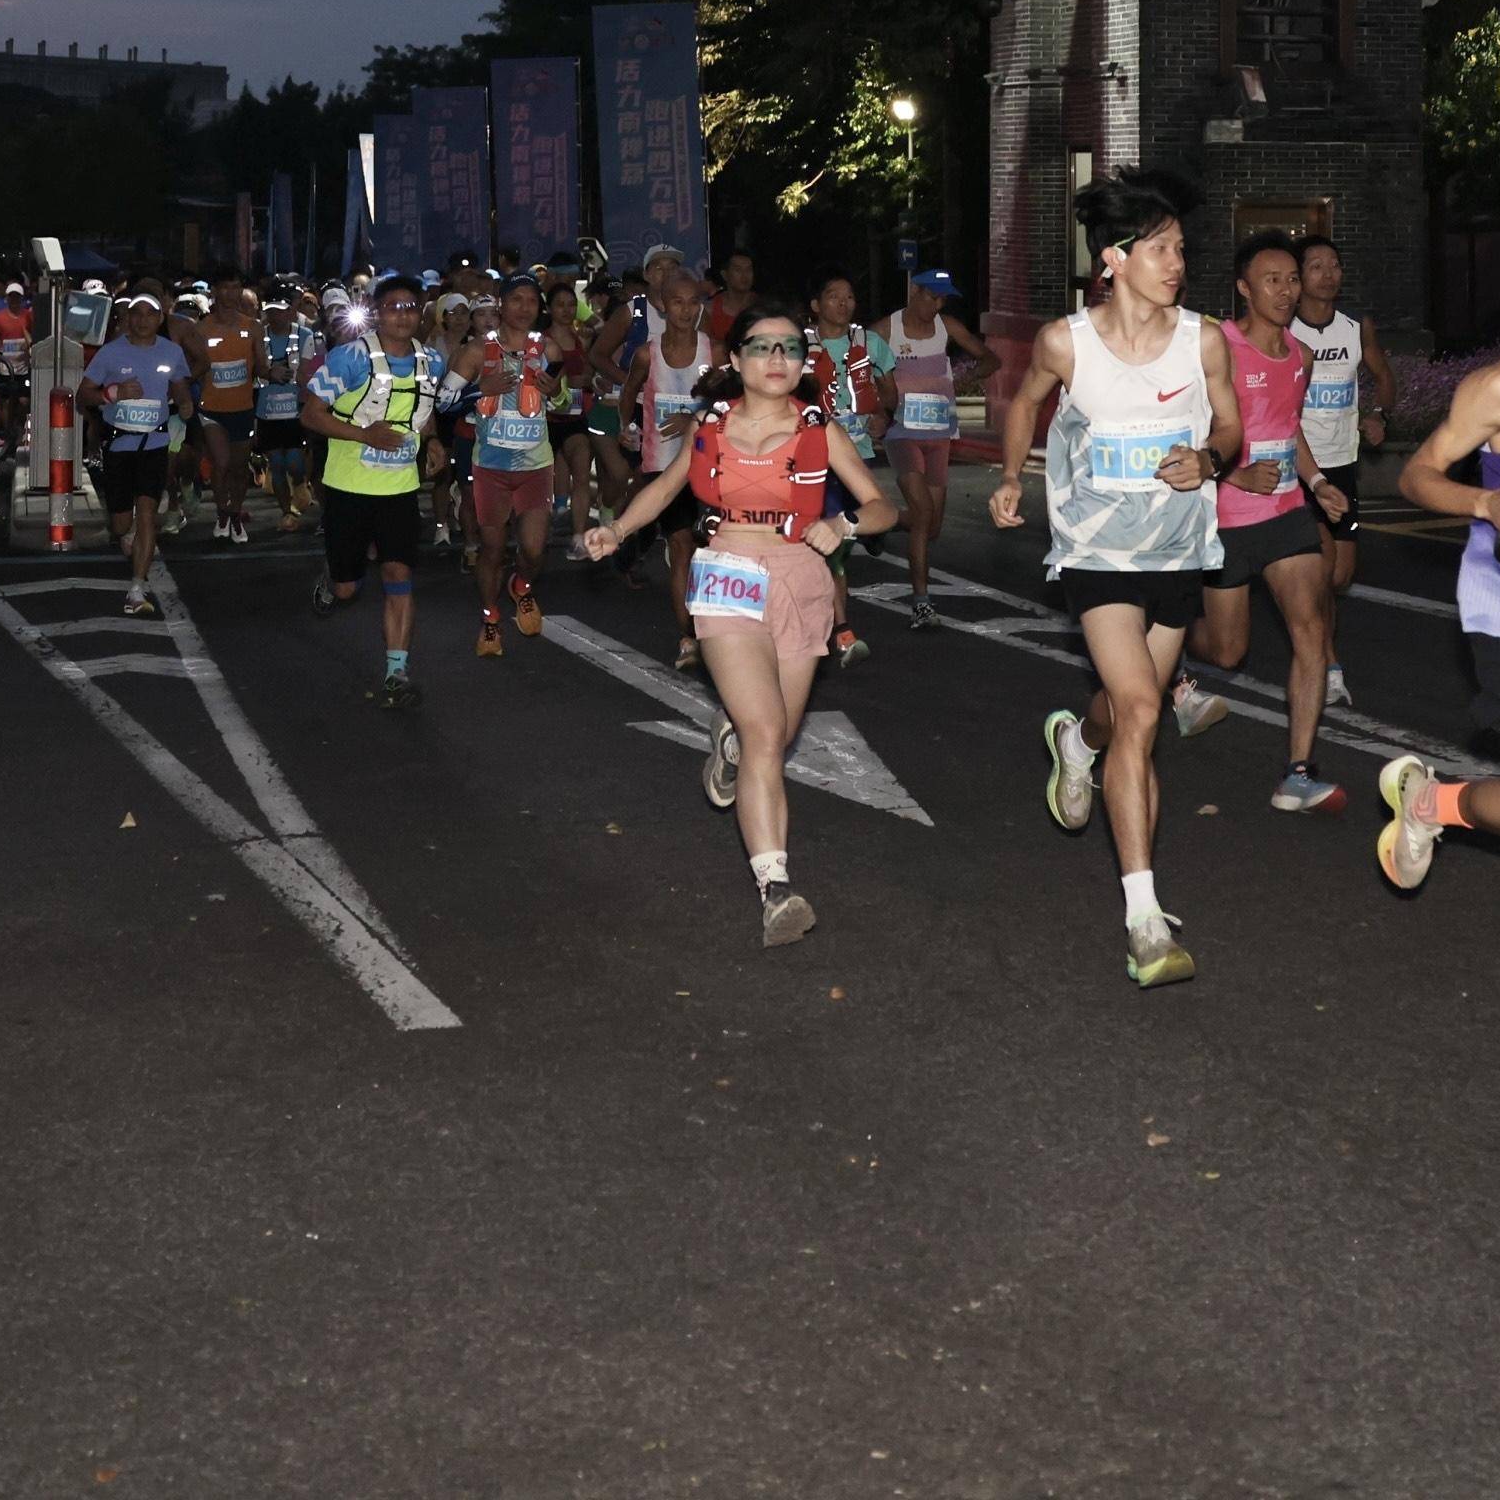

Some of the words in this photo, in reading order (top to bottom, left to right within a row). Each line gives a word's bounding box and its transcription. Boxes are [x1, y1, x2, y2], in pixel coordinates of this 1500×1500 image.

[115, 410, 125, 420] A
[130, 409, 159, 423] 0229
[490, 423, 501, 435] A
[507, 424, 542, 439] 0273
[365, 445, 376, 458] A
[1097, 446, 1115, 469] T
[1129, 440, 1188, 471] 09-
[704, 573, 762, 603] 2104
